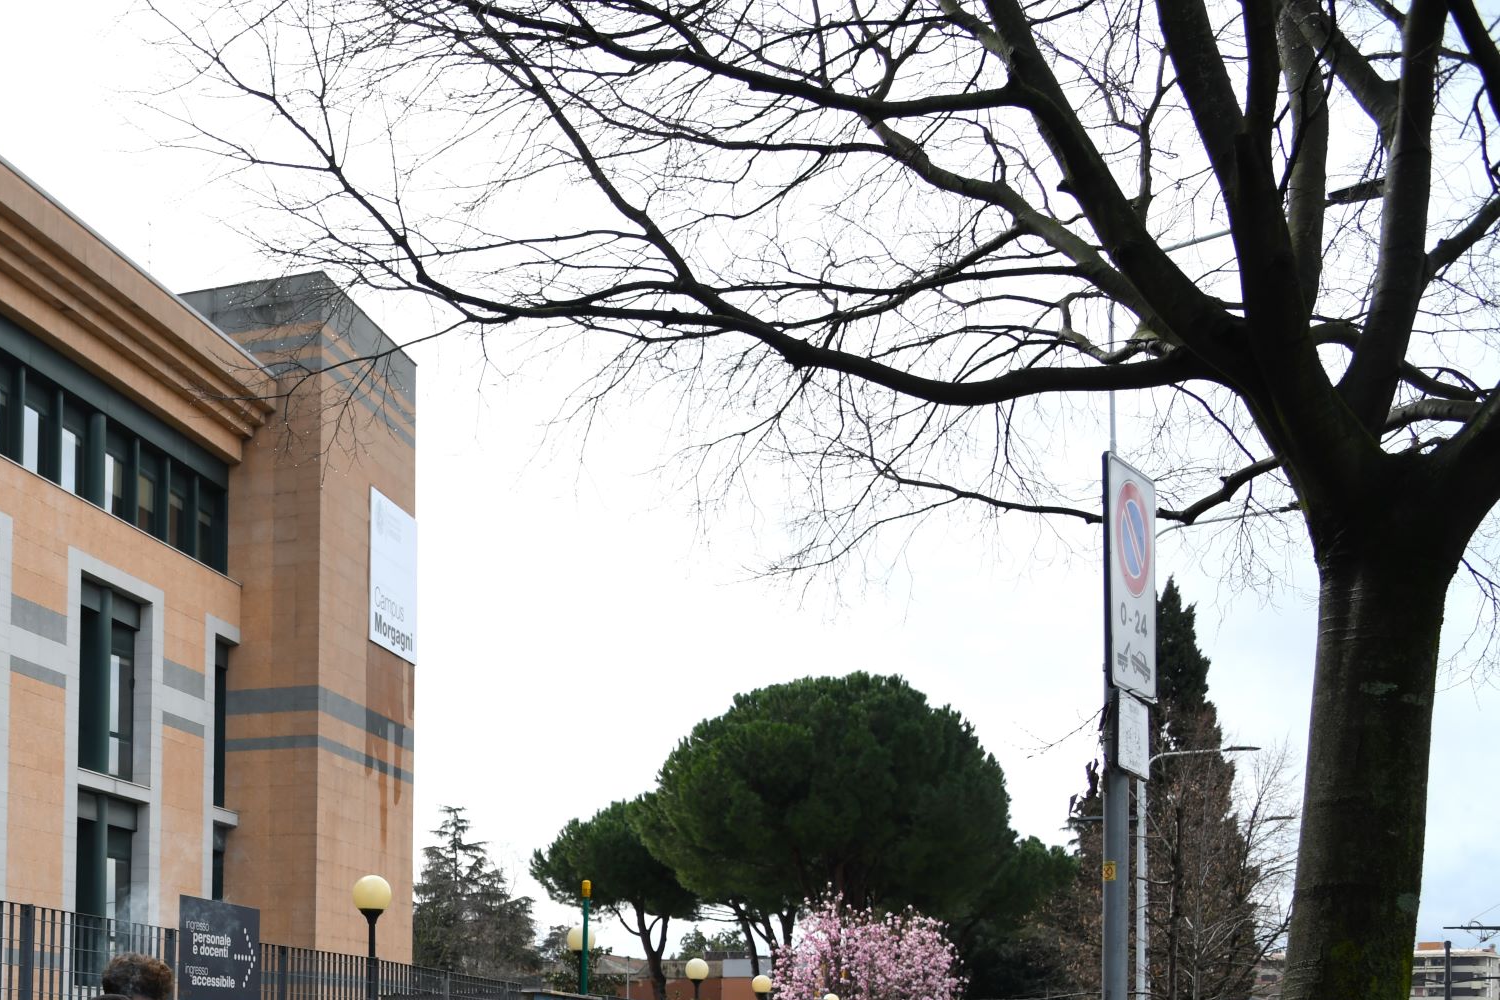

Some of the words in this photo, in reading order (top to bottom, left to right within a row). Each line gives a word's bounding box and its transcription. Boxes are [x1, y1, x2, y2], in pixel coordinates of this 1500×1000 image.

[374, 586, 404, 622] Campus
[374, 612, 413, 652] Morgagni
[186, 919, 209, 932] ingresso
[193, 932, 231, 946] personale
[200, 944, 229, 958] docenti
[185, 963, 208, 977] ingresso
[192, 975, 235, 988] accessibile
